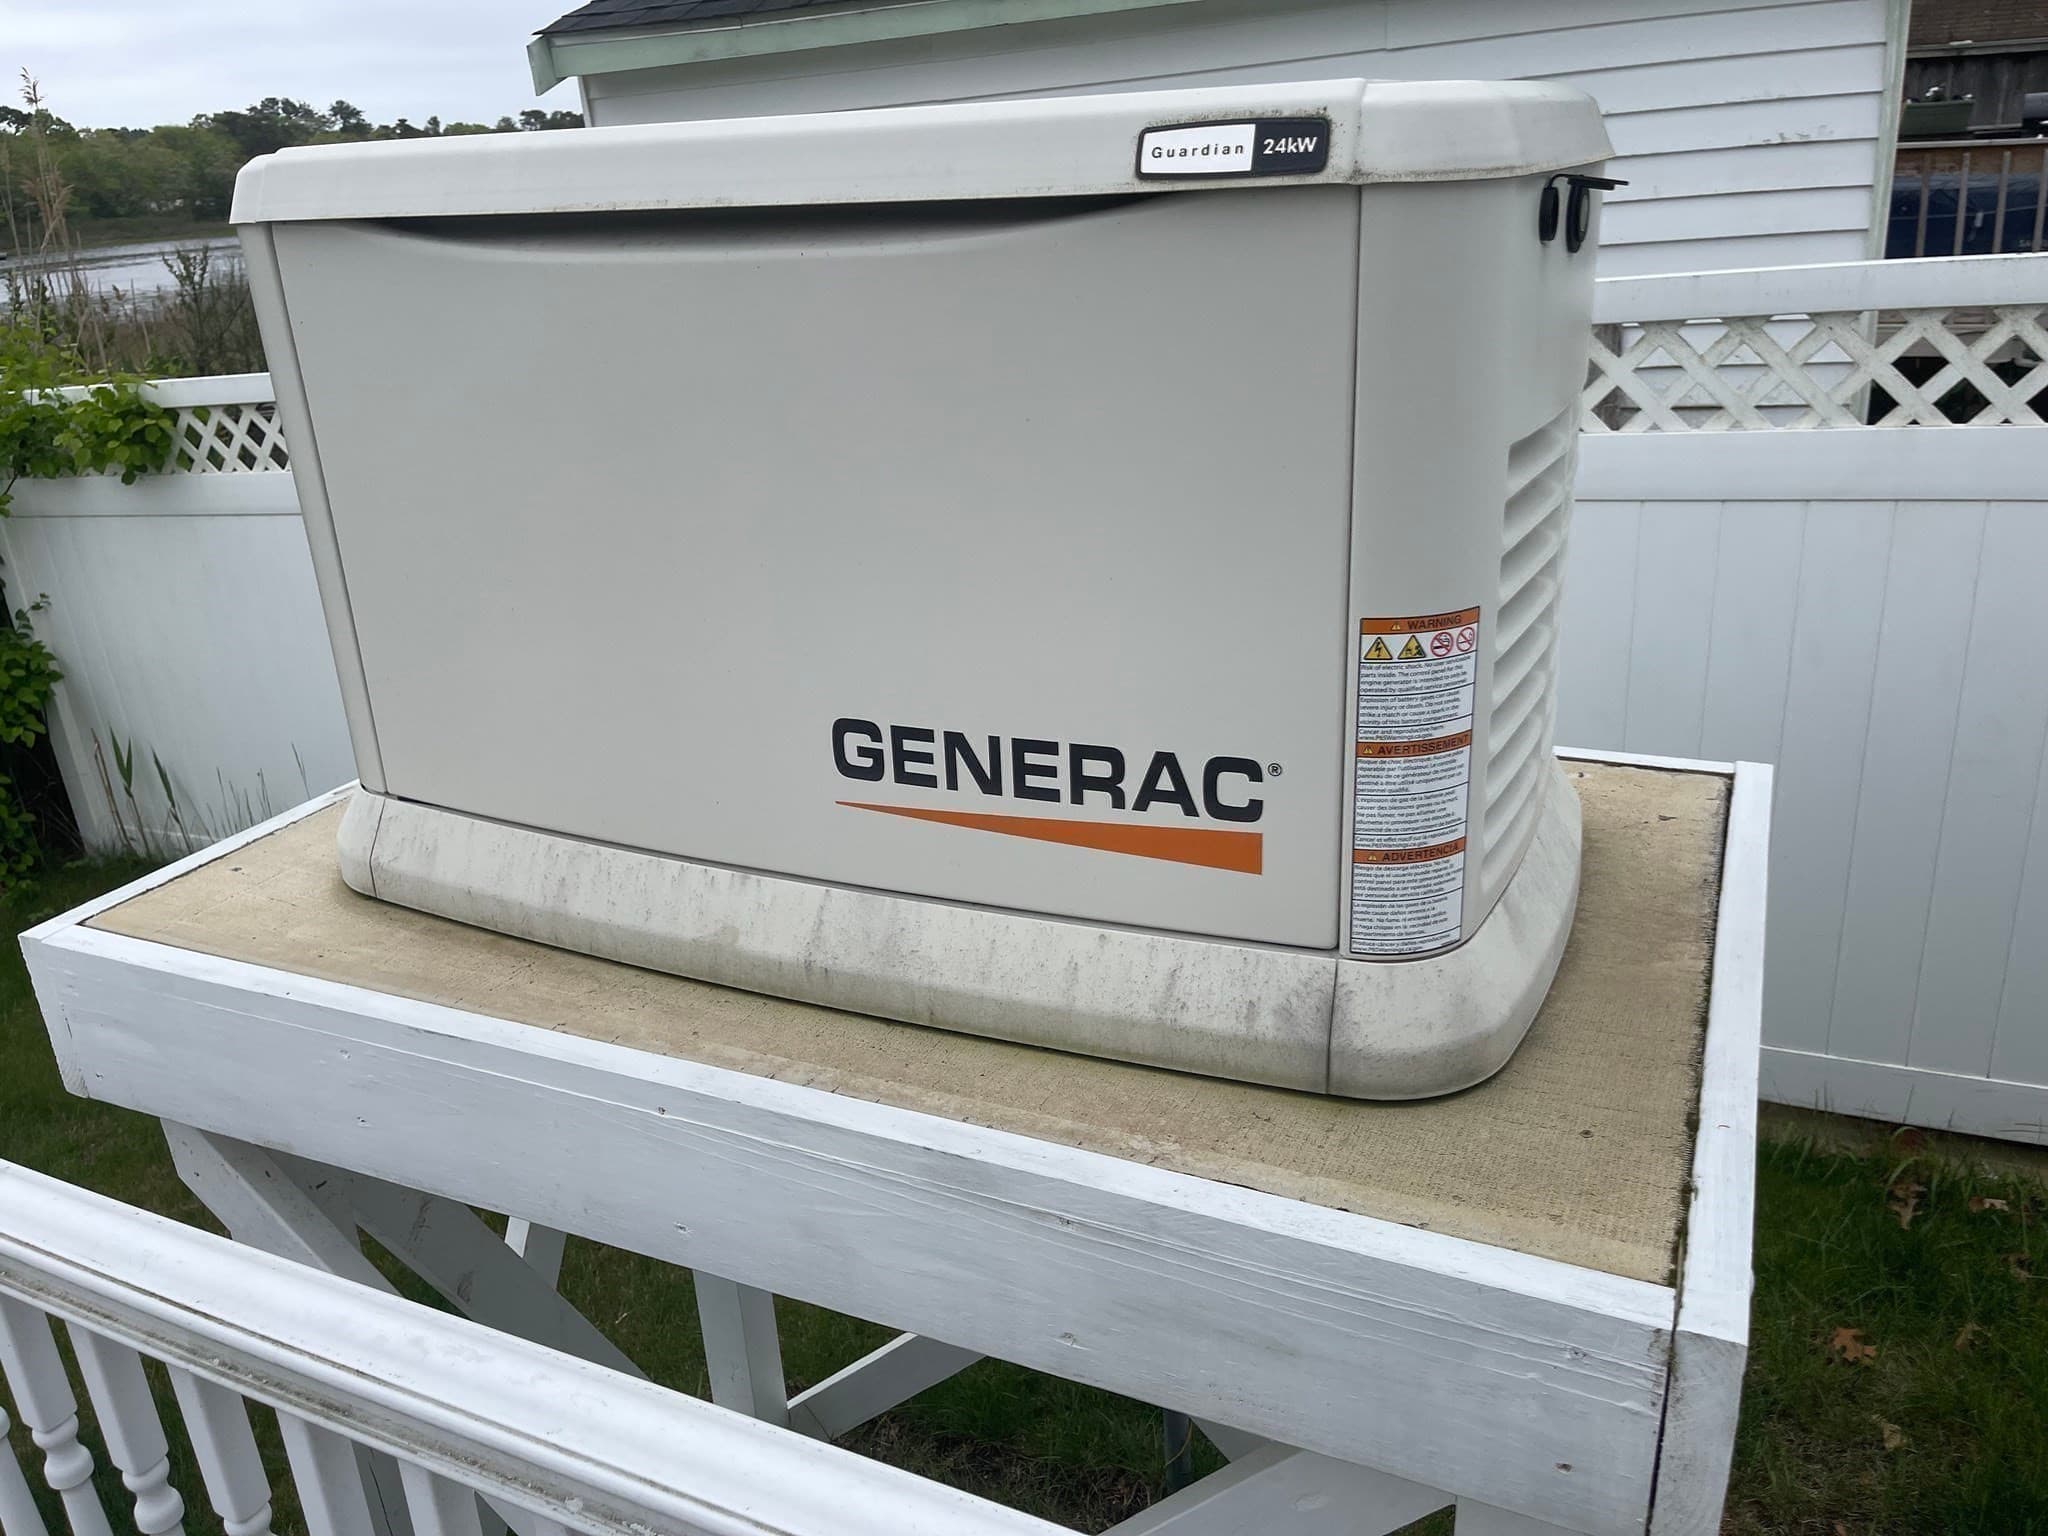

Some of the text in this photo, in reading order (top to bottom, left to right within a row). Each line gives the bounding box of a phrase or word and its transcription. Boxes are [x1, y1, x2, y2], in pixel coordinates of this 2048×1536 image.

[1151, 136, 1318, 158] Guardian 24kW
[1408, 615, 1461, 630] WARNING
[1383, 678, 1412, 687] generator
[1378, 734, 1468, 755] AVERTISSEMENT
[1382, 844, 1459, 861] ADVERTENCIA
